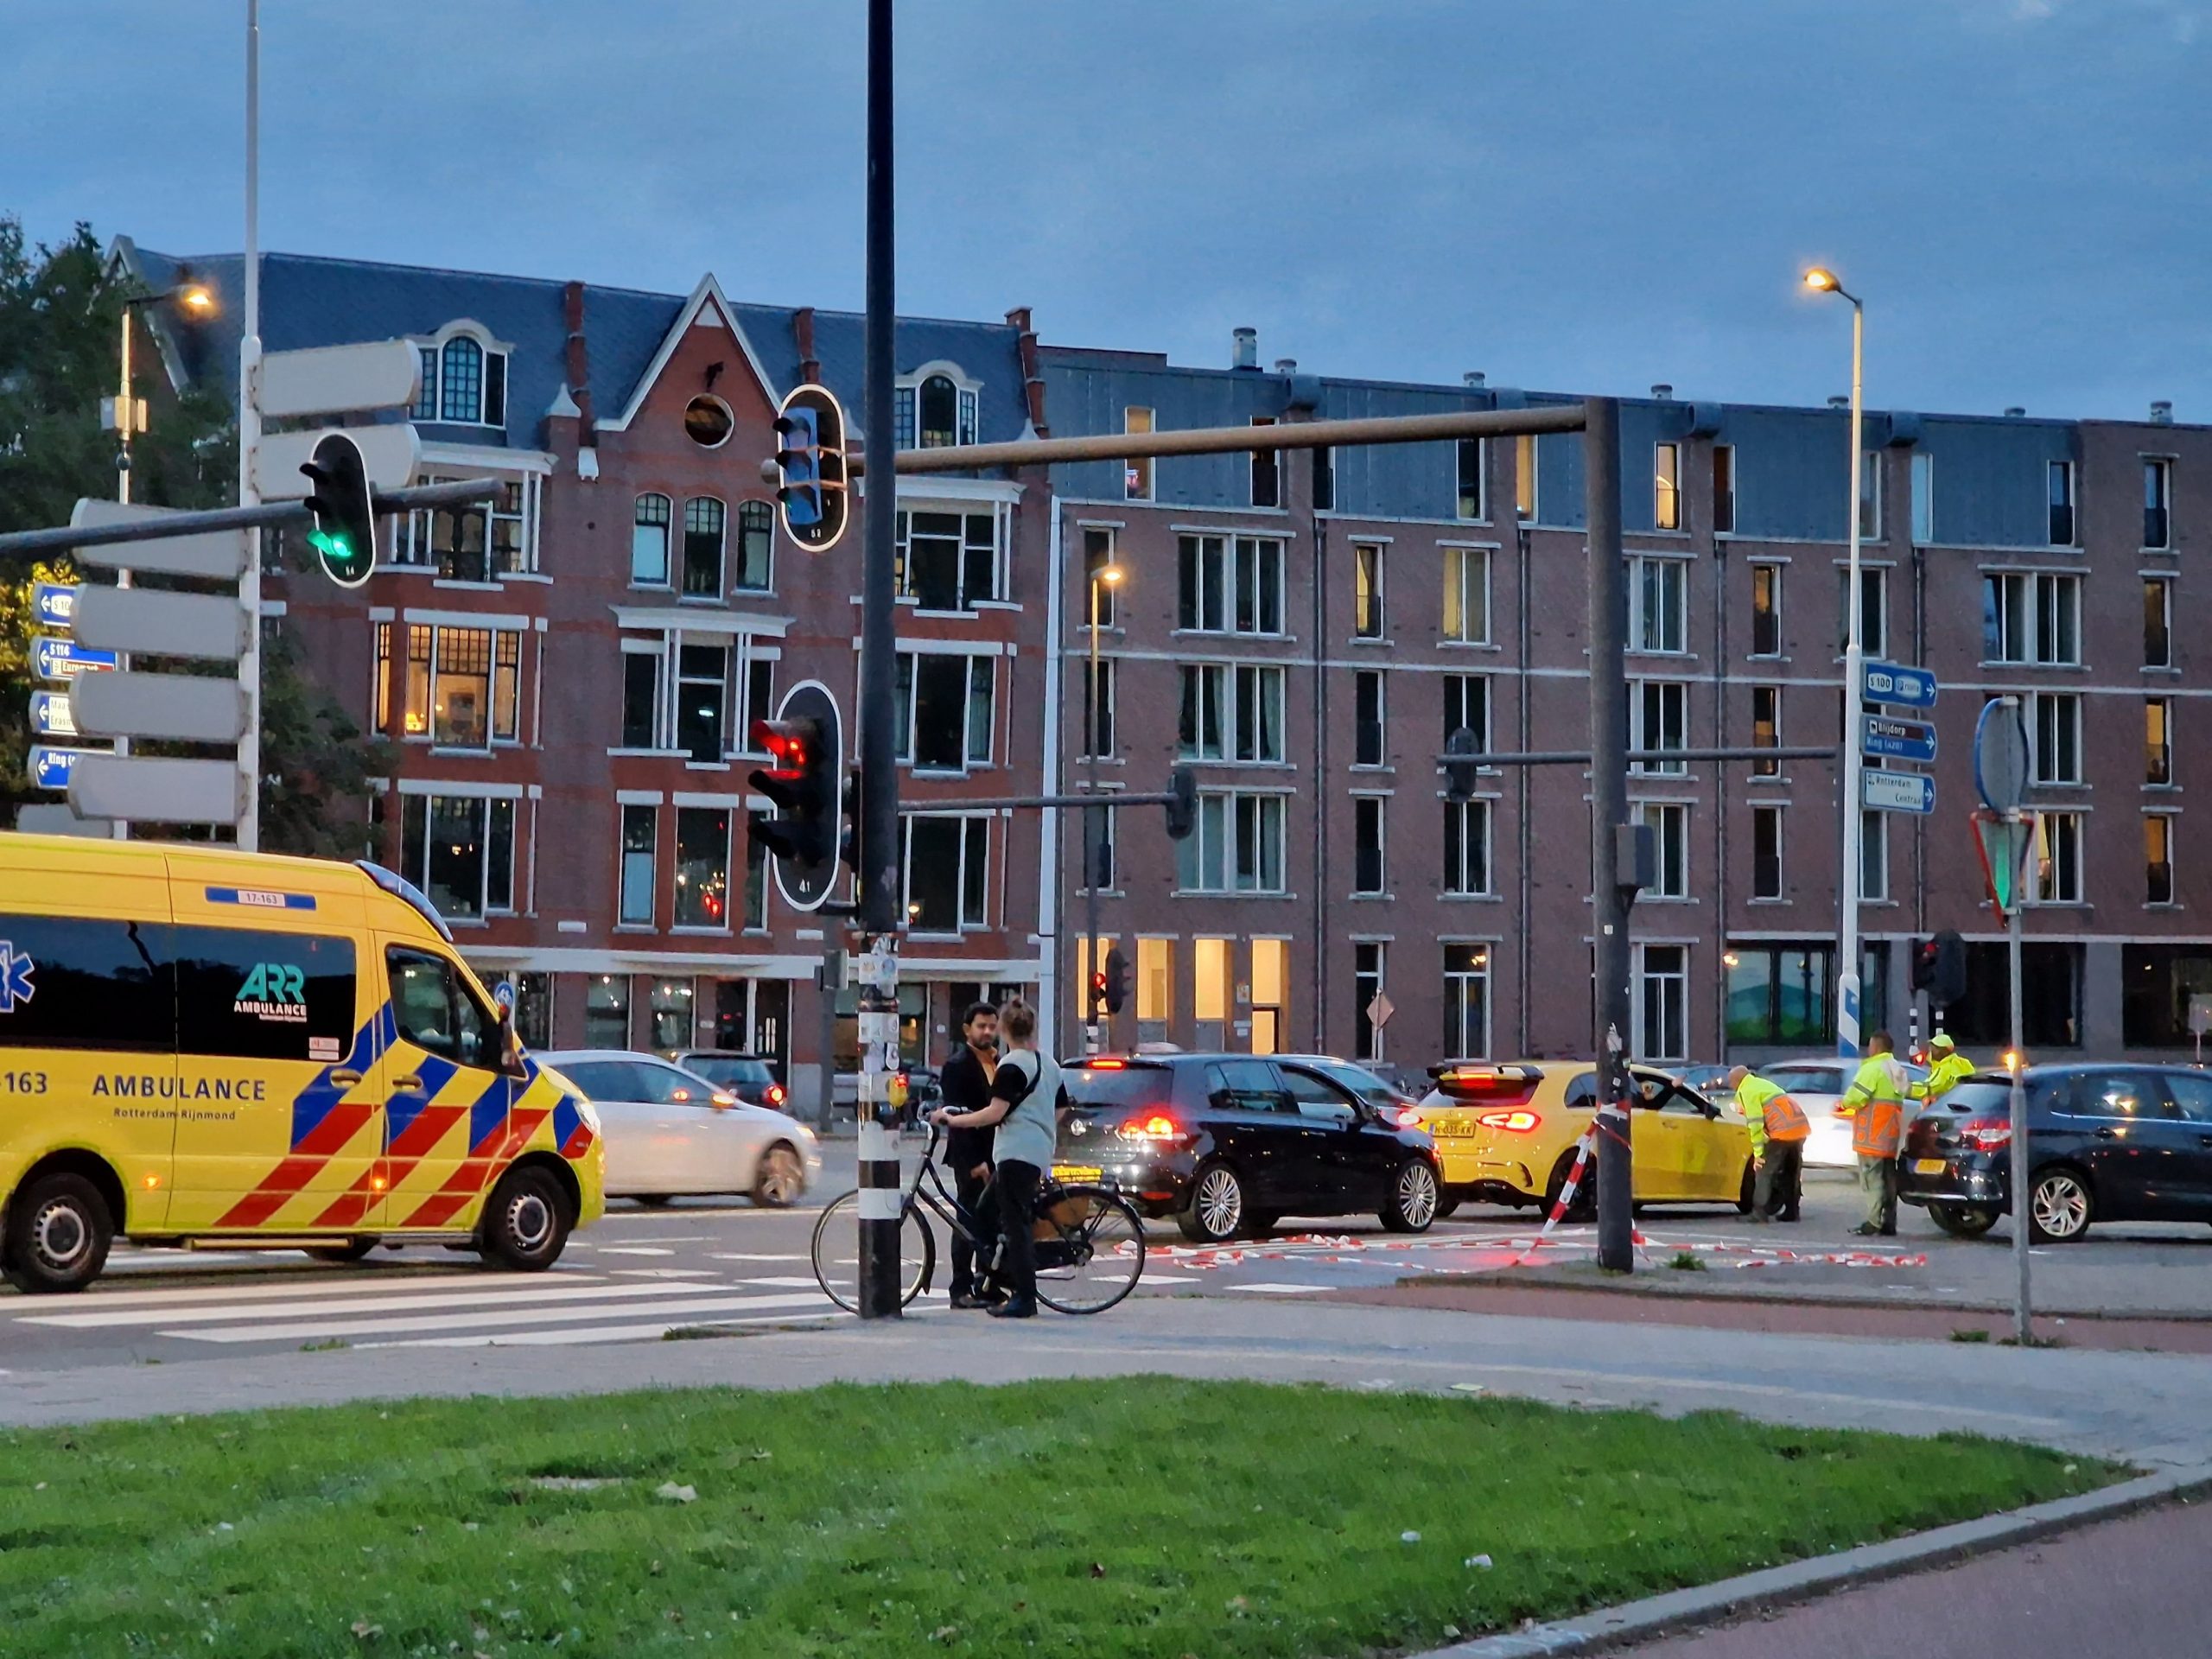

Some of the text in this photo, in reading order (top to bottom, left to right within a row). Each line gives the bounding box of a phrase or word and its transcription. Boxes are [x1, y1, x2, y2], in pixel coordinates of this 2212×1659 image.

[1877, 677, 1891, 688] 100
[48, 752, 67, 768] Ring
[246, 892, 277, 905] 17-163
[236, 963, 305, 1004] ARR
[233, 1001, 307, 1016] AMBULANCE
[92, 1073, 265, 1102] AMBULANCE
